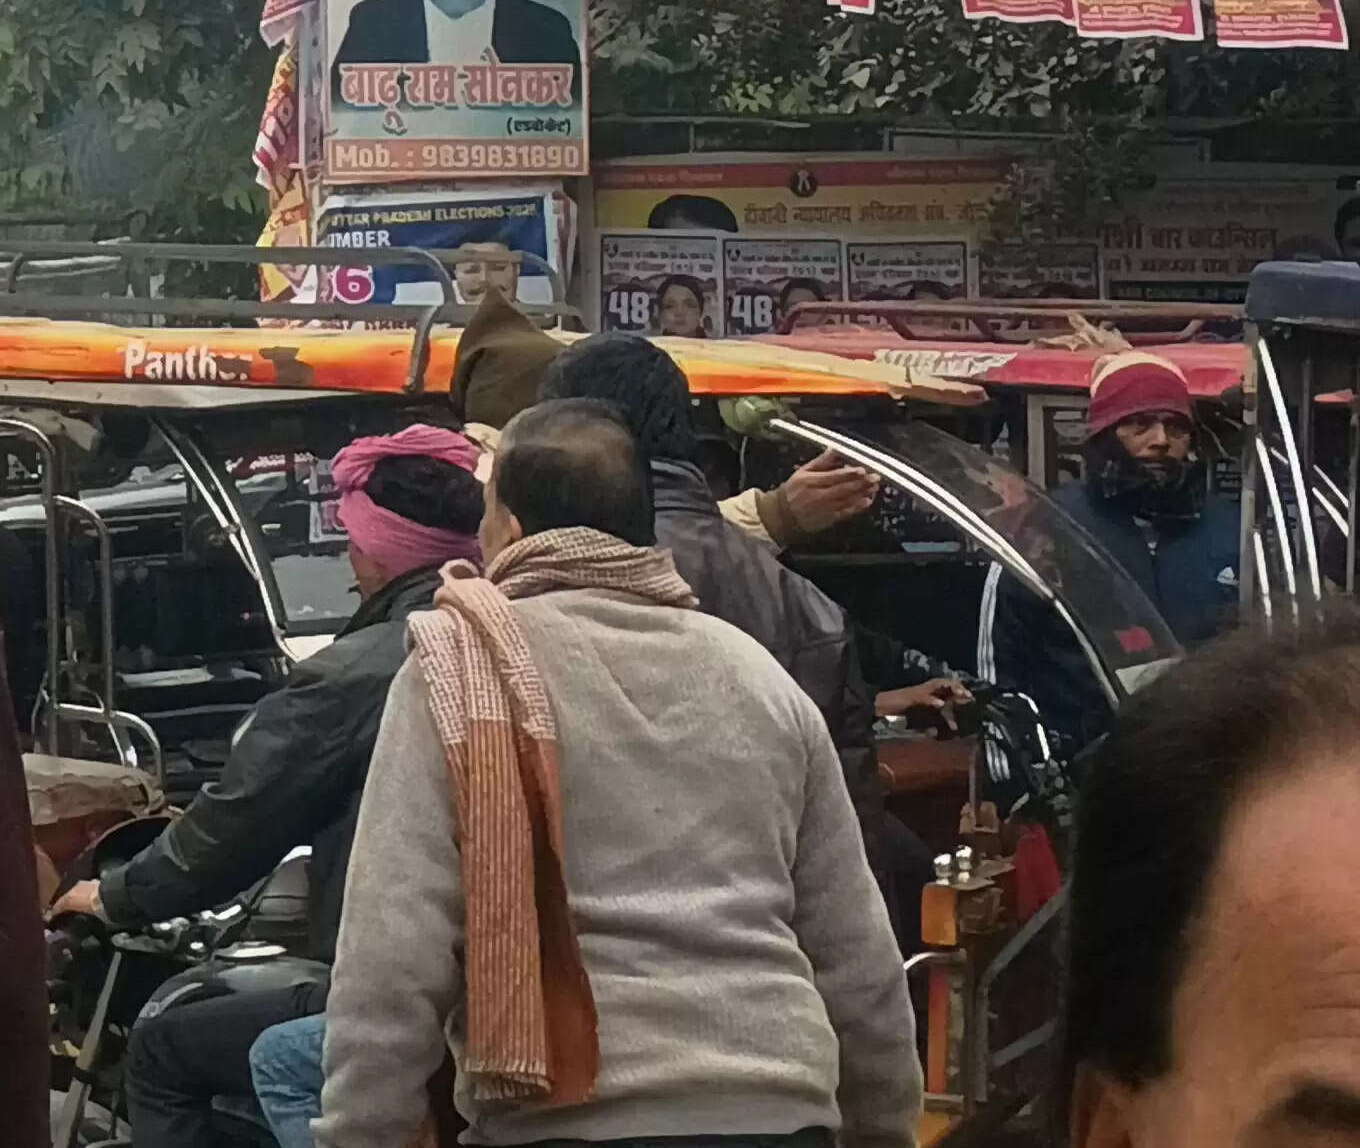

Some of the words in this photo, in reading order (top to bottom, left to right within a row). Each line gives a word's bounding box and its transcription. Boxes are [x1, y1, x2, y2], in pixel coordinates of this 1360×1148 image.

[402, 64, 458, 103] राम
[335, 144, 399, 169] Mob.
[608, 290, 650, 325] 48
[730, 294, 773, 328] 48
[124, 338, 254, 381] Panth
